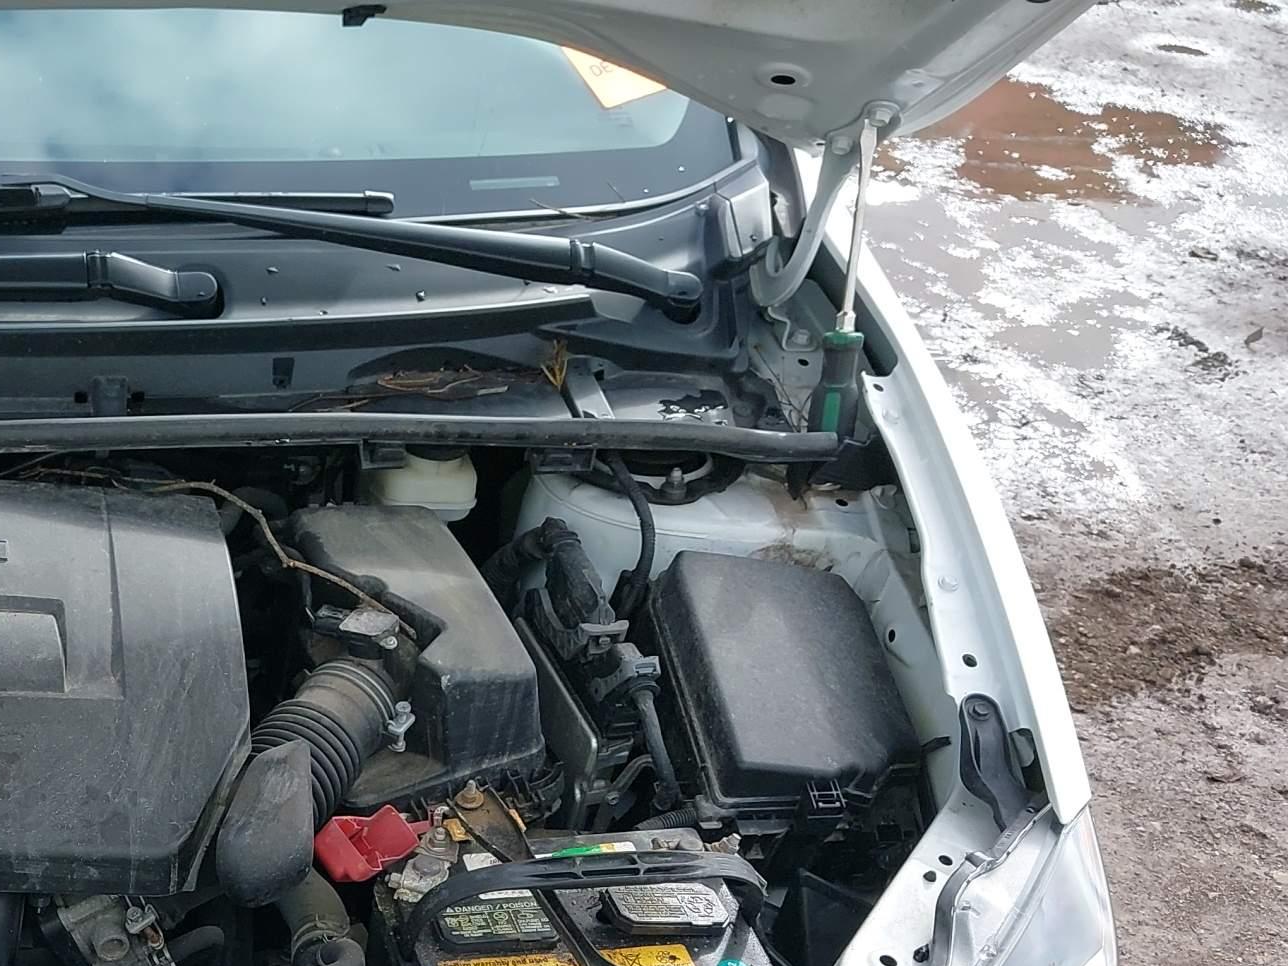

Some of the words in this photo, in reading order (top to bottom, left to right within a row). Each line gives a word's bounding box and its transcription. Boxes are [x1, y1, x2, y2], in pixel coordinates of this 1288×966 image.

[454, 904, 493, 913] DANGER
[502, 901, 538, 909] POISON
[511, 958, 526, 966] and
